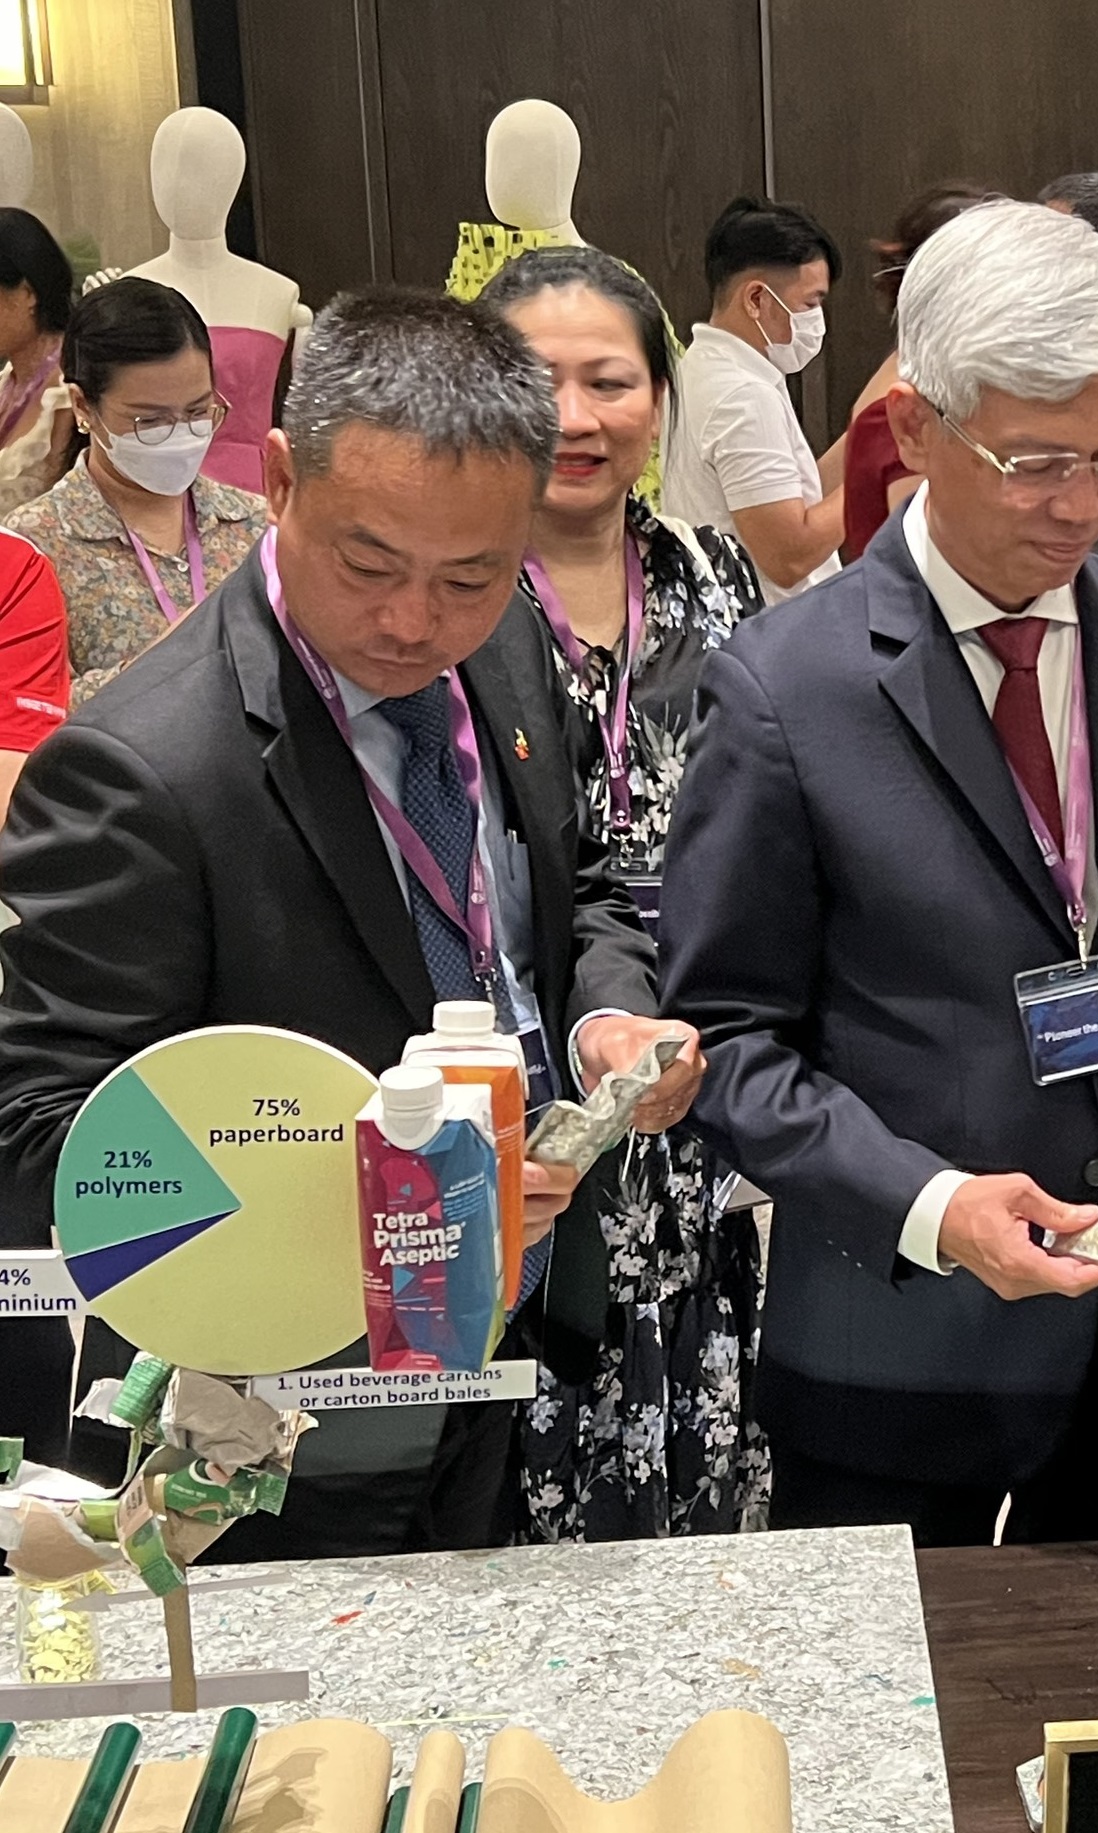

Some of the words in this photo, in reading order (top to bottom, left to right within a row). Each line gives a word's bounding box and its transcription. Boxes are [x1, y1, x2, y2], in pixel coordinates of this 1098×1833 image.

[252, 1098, 300, 1117] 75%
[209, 1123, 344, 1147] paperboard
[104, 1149, 152, 1169] 21%
[75, 1175, 183, 1198] polymers
[372, 1211, 428, 1230] Tetra
[380, 1243, 460, 1266] Aseptic
[0, 1268, 31, 1286] 4%
[278, 1377, 293, 1391] 1.
[299, 1373, 343, 1390] Used
[350, 1370, 431, 1388] beverage
[299, 1396, 319, 1408] or
[324, 1392, 382, 1407] carton
[387, 1388, 439, 1404] board
[444, 1386, 491, 1400] bales
